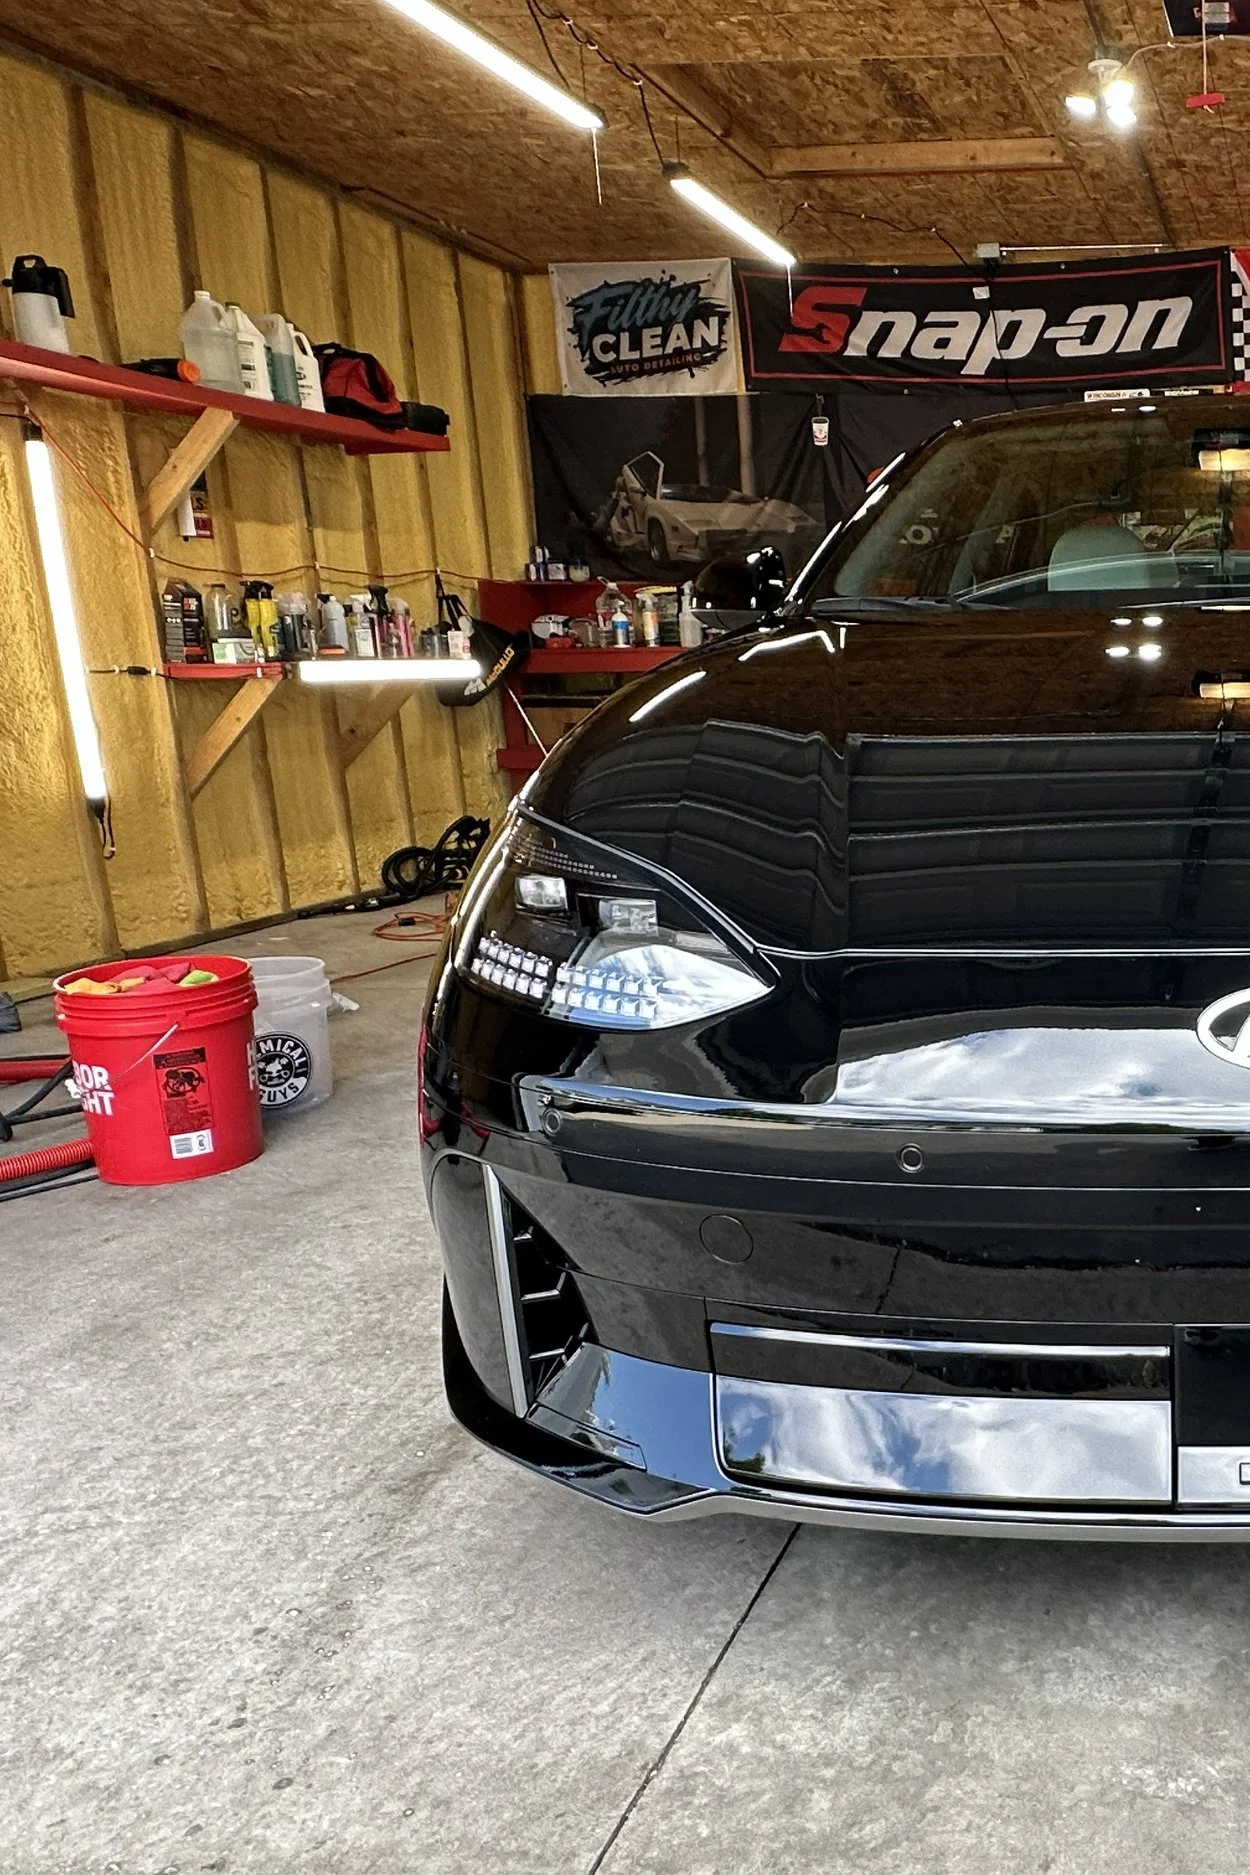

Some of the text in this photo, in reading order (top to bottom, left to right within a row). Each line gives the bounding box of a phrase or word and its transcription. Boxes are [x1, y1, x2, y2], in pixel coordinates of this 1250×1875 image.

[572, 281, 698, 354] Filthy
[592, 315, 719, 363] CLEAN
[778, 286, 1193, 375] Snap-on
[610, 352, 701, 374] AUTO DETAILING
[256, 1039, 307, 1068] MICAL
